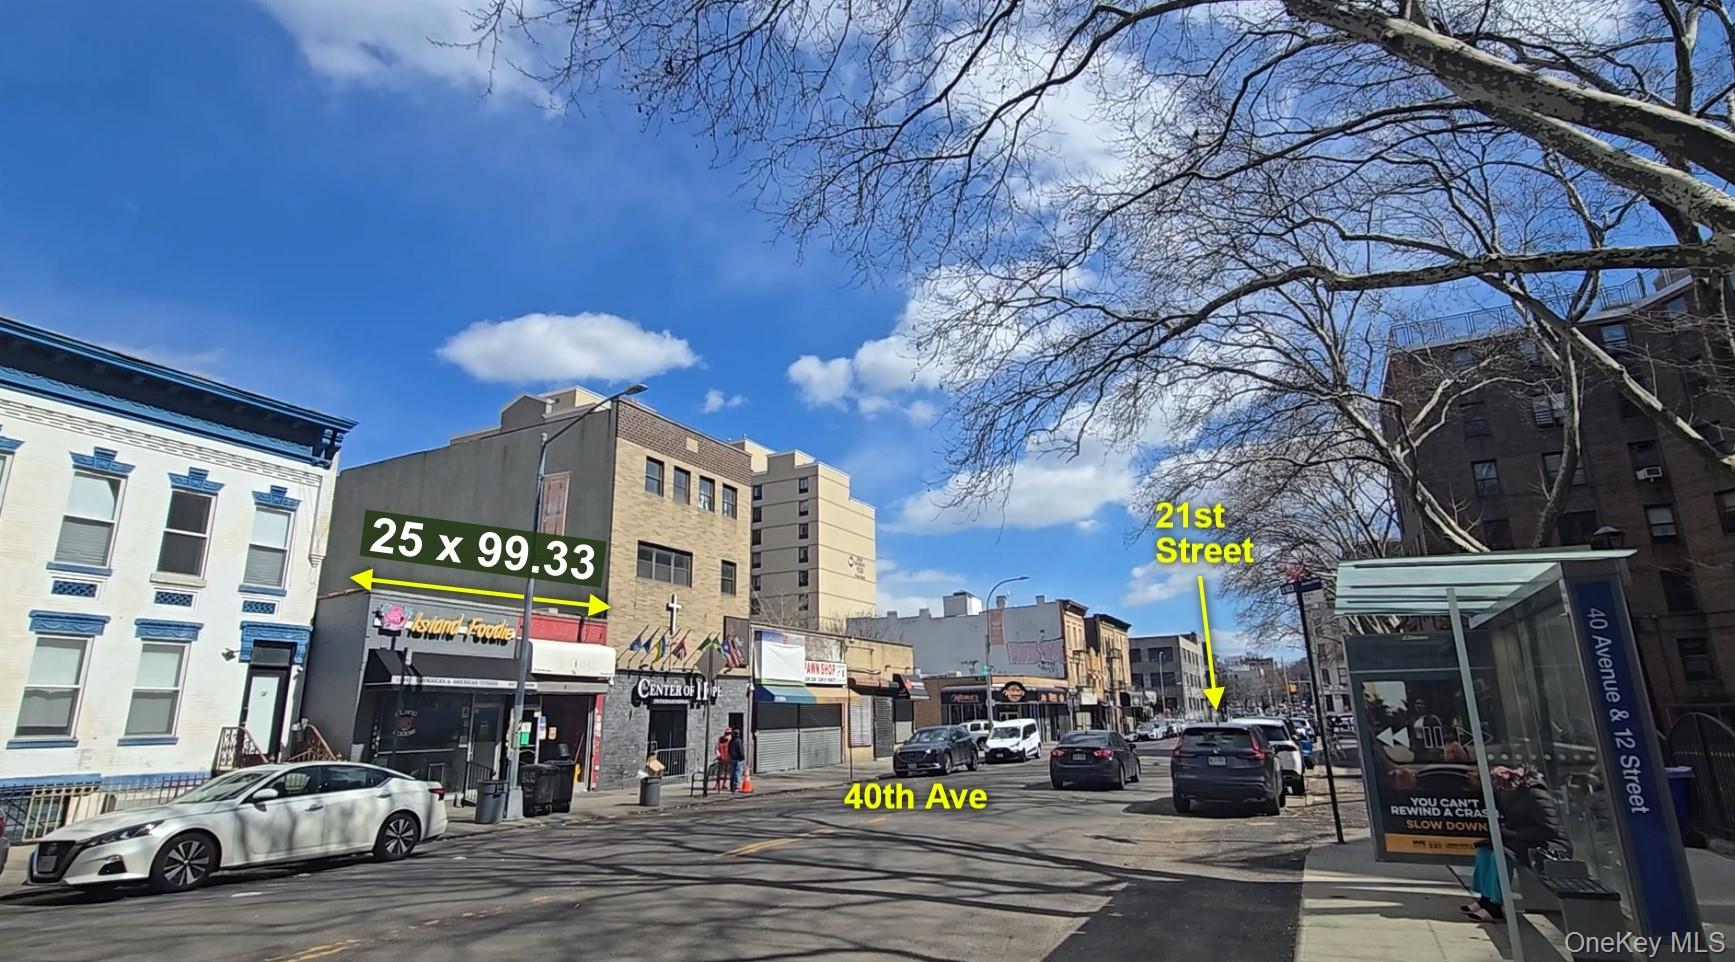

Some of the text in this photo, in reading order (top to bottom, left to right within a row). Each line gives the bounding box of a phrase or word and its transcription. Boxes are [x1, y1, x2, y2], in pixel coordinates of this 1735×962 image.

[412, 611, 516, 640] Island Foodie
[821, 663, 836, 675] SHOP
[638, 678, 722, 701] CENTER OF HPE
[1587, 607, 1650, 813] 40 Avenue & 12 Street
[1410, 797, 1479, 808] YOU CAN'T
[1391, 806, 1440, 817] REWIND
[1443, 808, 1453, 817] A
[1406, 820, 1442, 830] SLOW
